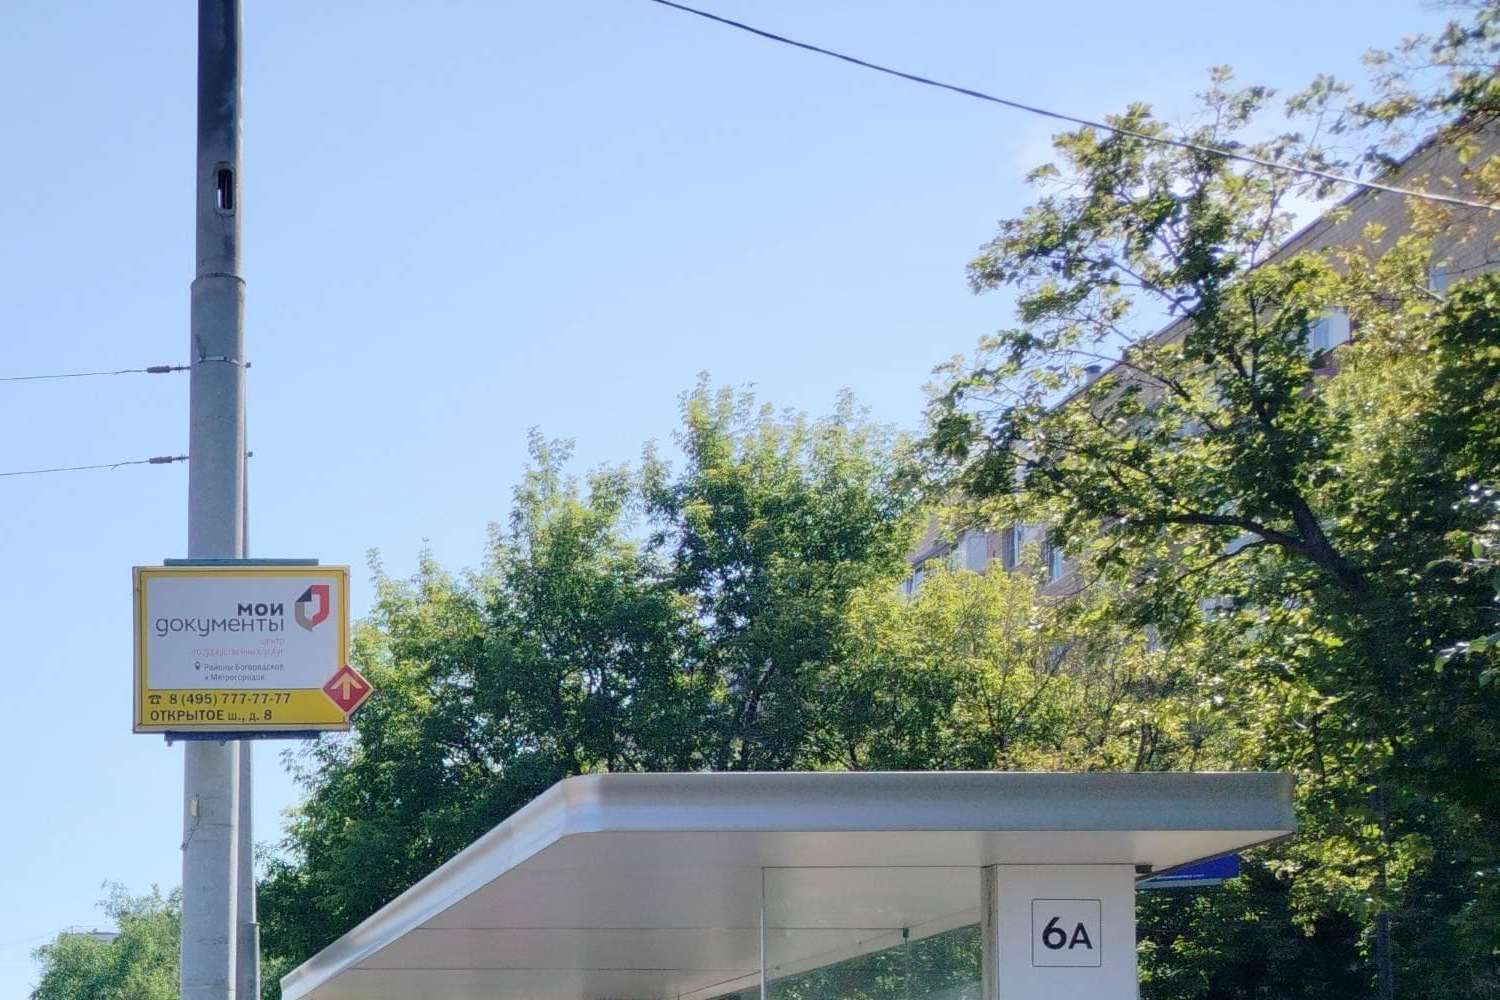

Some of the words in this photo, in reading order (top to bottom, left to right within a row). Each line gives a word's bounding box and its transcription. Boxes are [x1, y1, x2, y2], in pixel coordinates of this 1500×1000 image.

[237, 602, 284, 616] мои
[155, 618, 284, 637] документы
[211, 674, 265, 682] Метрогородок
[169, 693, 178, 705] 8
[181, 692, 218, 706] (495)
[222, 693, 291, 704] 777-77-77
[150, 710, 224, 721] ОТКРЫТОЕ
[249, 712, 260, 723] д.
[264, 710, 272, 720] 8
[1042, 916, 1094, 950] 6А
